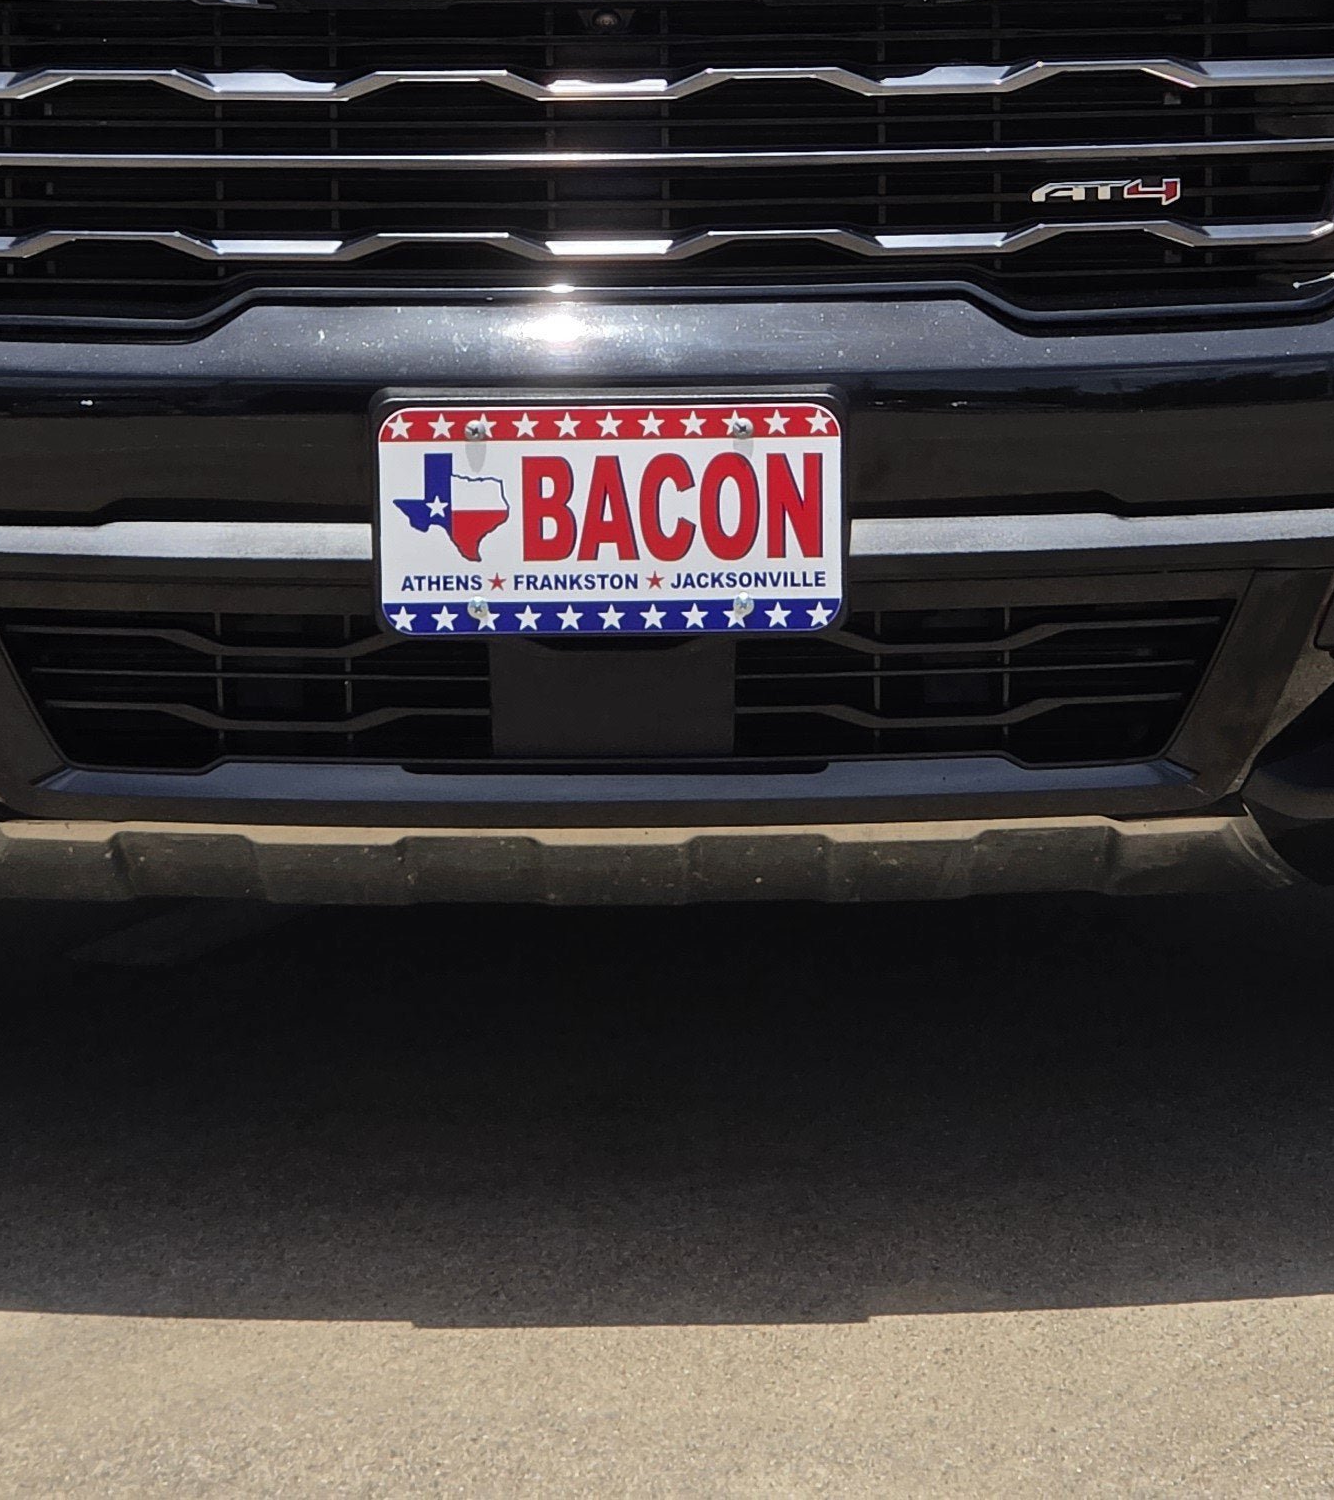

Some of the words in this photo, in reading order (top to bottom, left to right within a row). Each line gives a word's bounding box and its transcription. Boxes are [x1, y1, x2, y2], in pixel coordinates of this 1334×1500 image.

[1031, 178, 1181, 206] AT4
[522, 452, 824, 562] BACON
[401, 574, 483, 592] ATHENS
[513, 573, 639, 591] FRANKSTON
[670, 570, 826, 589] JACKSONVILLE
